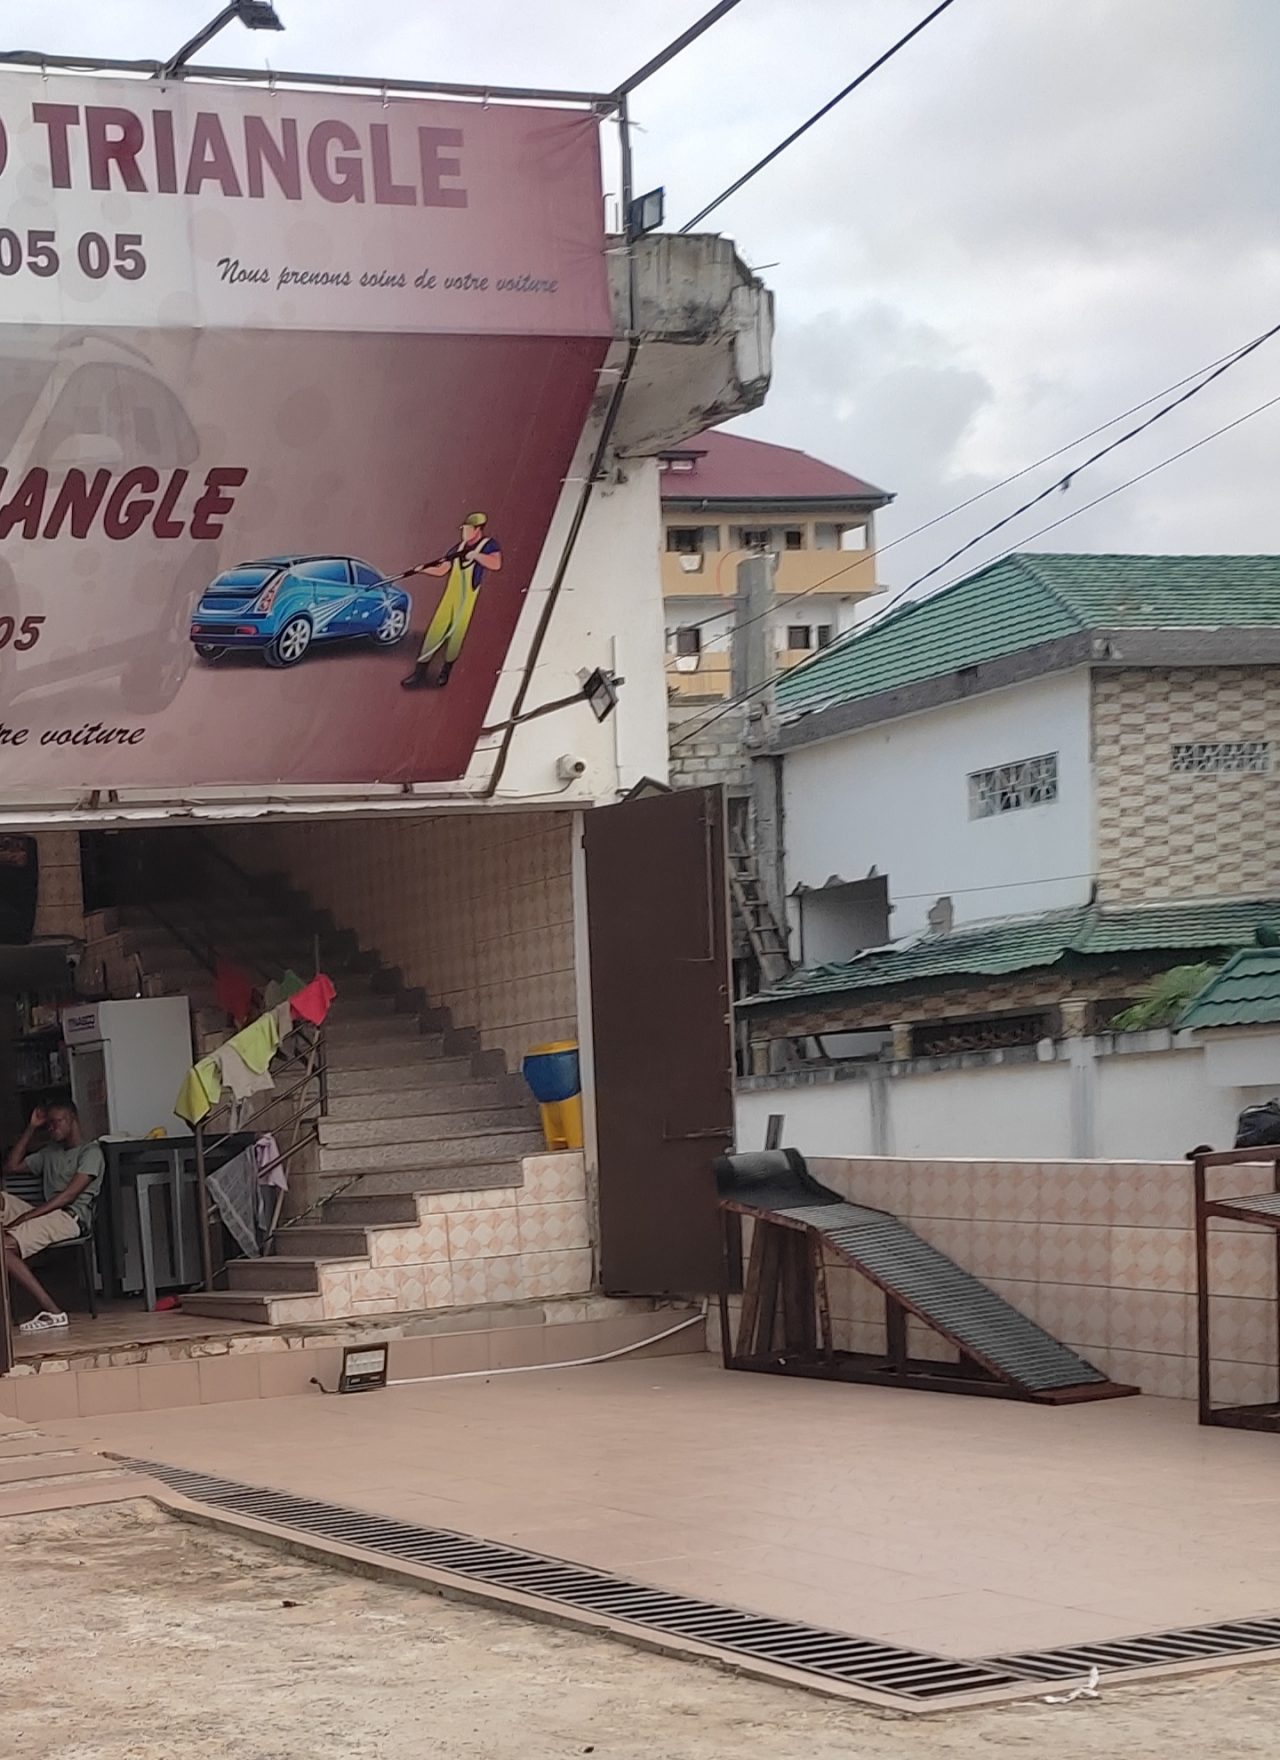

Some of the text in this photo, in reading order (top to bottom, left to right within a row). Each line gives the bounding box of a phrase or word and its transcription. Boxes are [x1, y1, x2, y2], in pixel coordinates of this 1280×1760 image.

[32, 102, 469, 208] TRIANGLE
[77, 230, 148, 281] 05
[216, 257, 559, 296] Nous prenons soins de votre voiture
[40, 720, 145, 748] voiture
